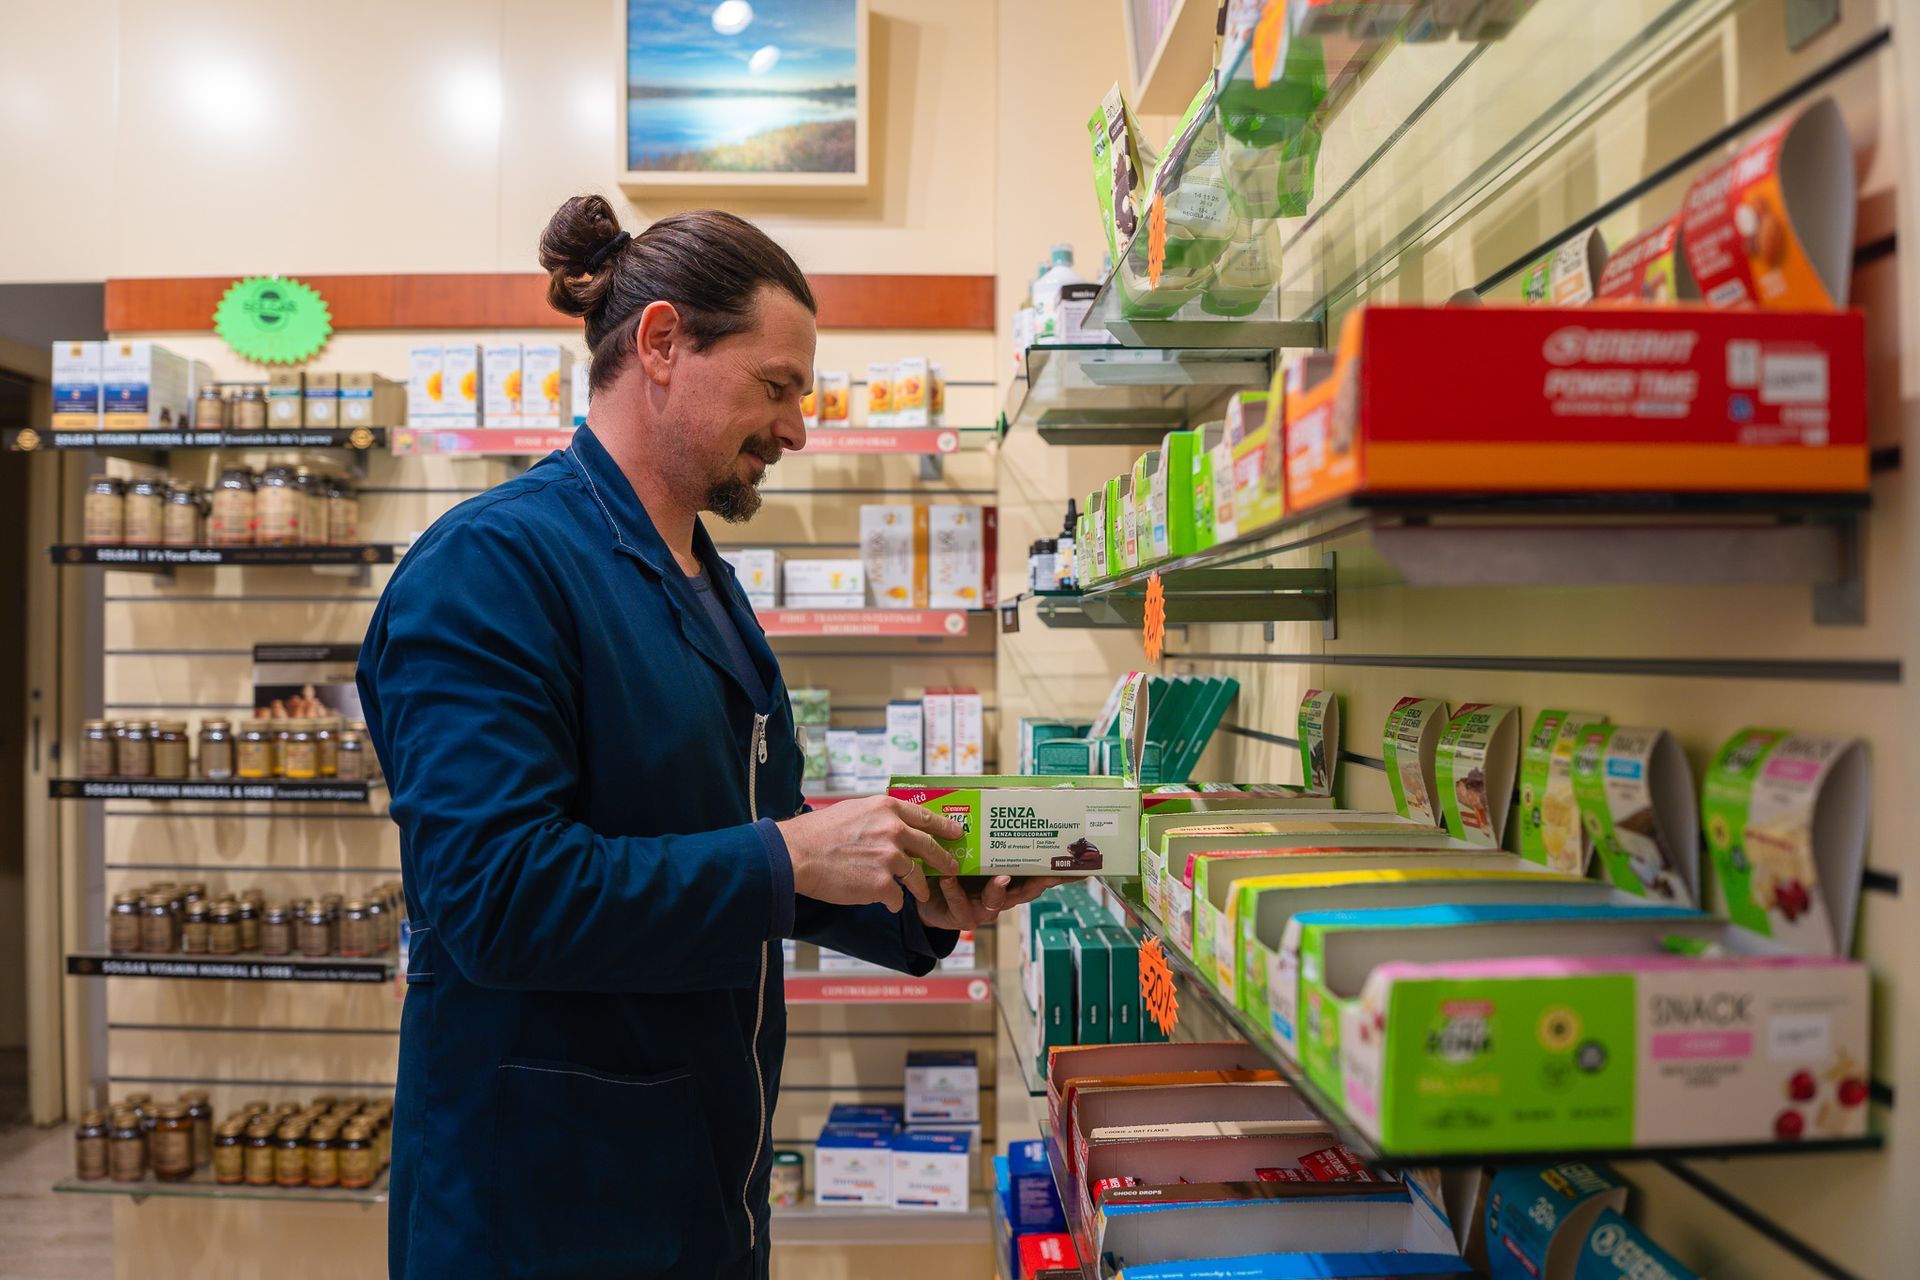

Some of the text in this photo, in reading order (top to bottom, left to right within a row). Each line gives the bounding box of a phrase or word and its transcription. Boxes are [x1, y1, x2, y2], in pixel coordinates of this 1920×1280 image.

[1543, 369, 1698, 401] POWER TIME
[990, 807, 1036, 818] SENZA
[990, 819, 1049, 829] ZUCCHERI
[990, 840, 1007, 849] 30%
[1055, 860, 1071, 868] NOIR
[1650, 992, 1752, 1027] SNACK
